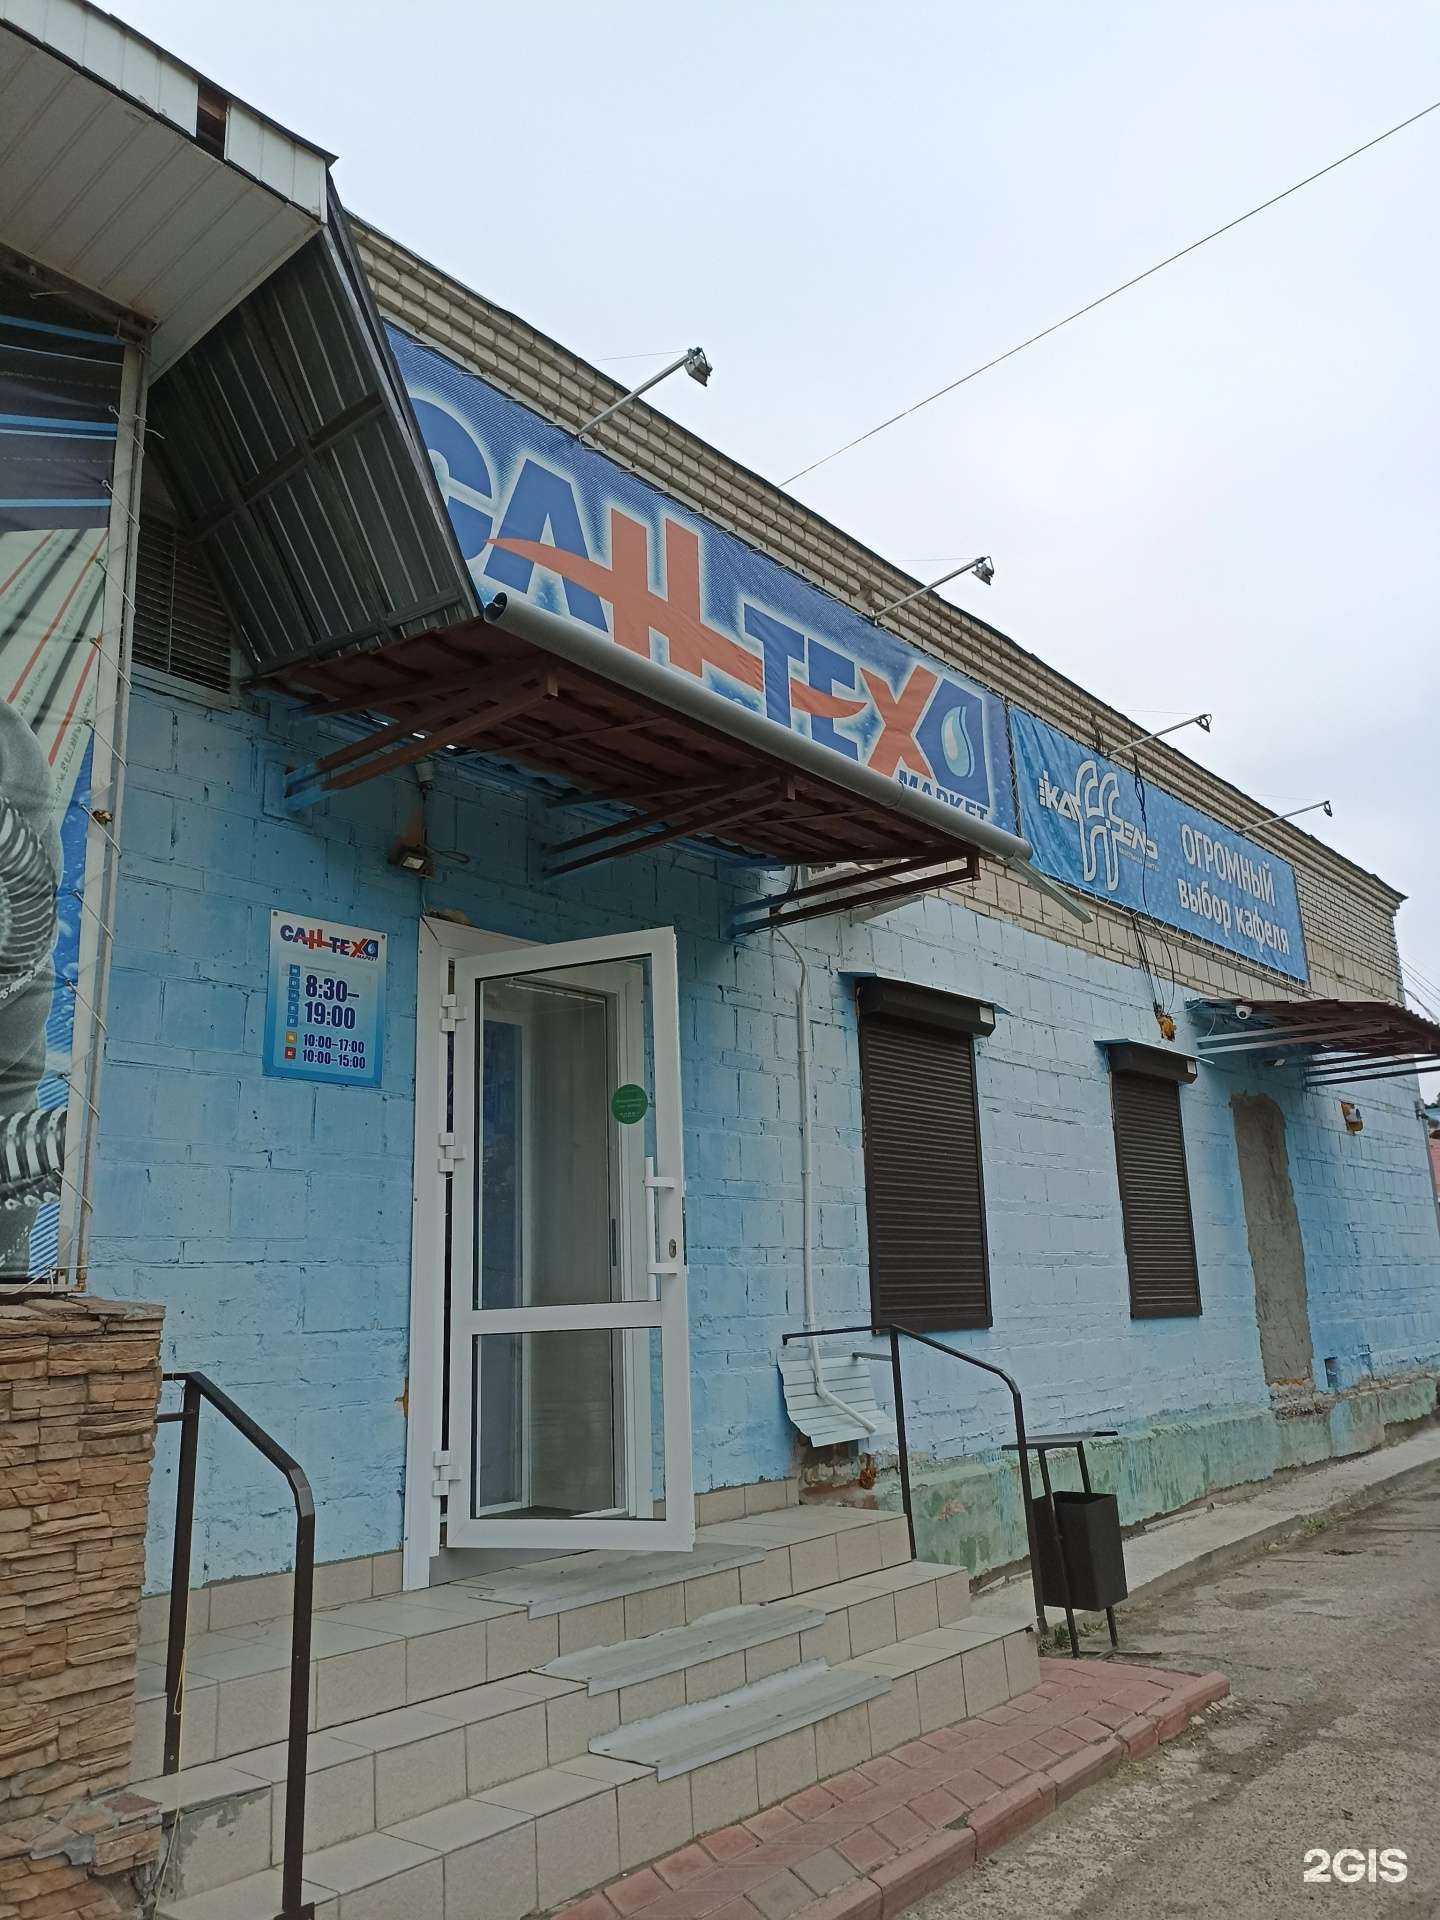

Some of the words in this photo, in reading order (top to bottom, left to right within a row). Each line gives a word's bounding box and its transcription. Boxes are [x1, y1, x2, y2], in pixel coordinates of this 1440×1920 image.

[1181, 823, 1276, 907] ОГРОМНЫЙ
[1234, 905, 1290, 956] кафеля
[304, 1001, 356, 1030] 19:00
